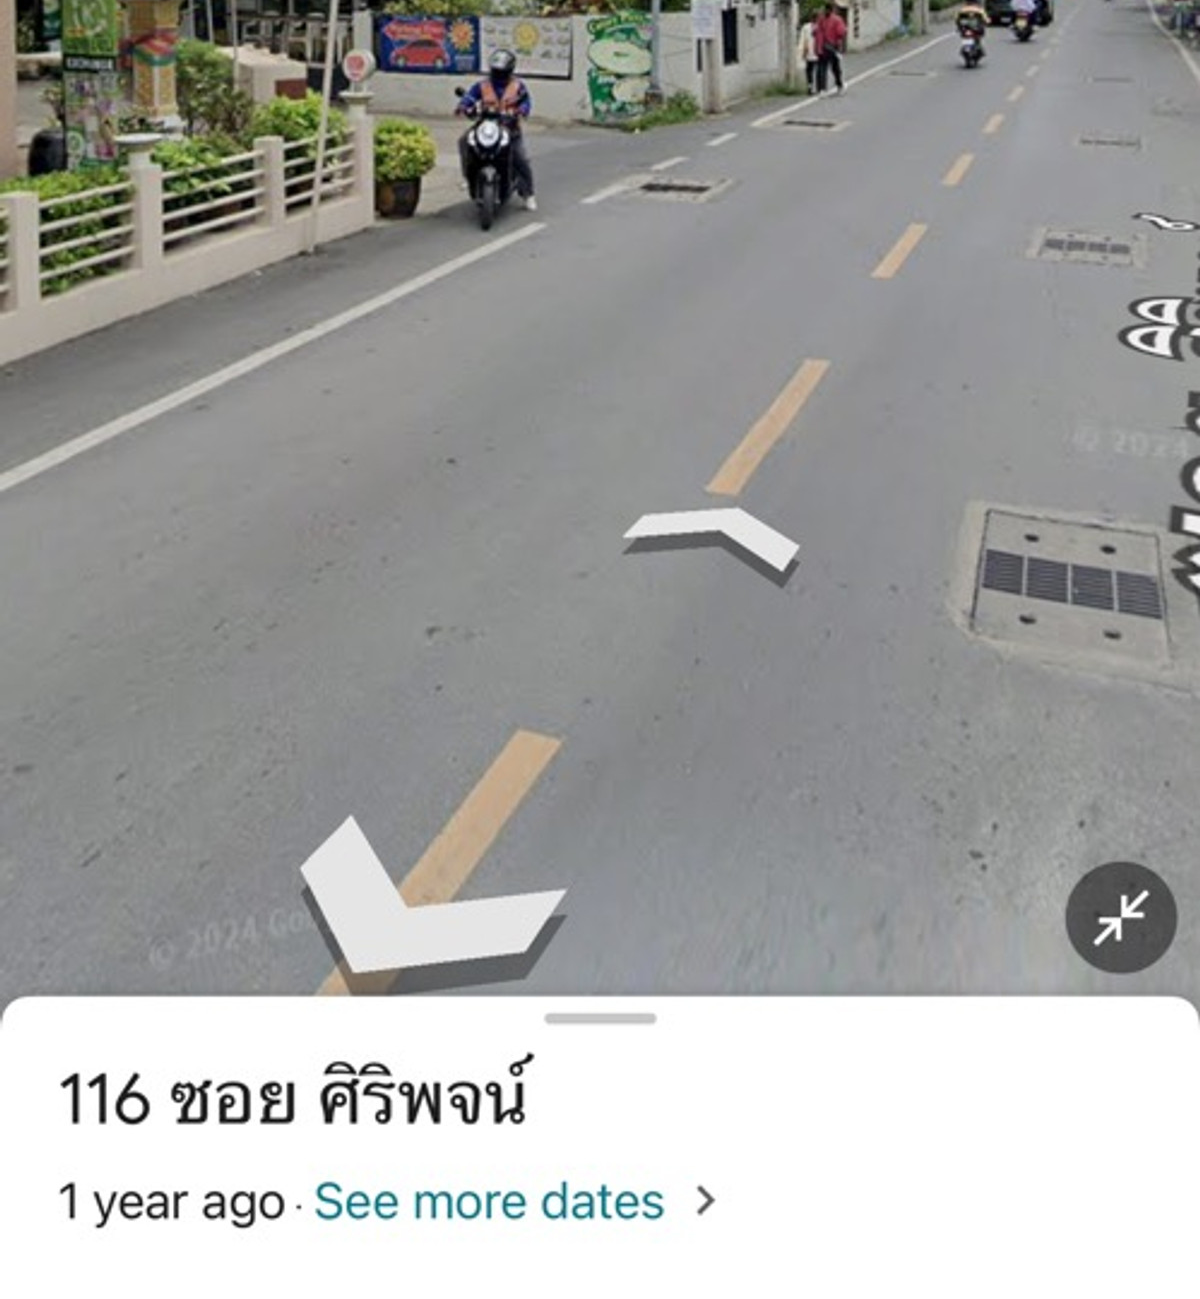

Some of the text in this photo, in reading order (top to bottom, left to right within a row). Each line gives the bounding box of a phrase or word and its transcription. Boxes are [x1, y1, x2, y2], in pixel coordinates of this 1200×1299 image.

[60, 1052, 535, 1125] 116 ซอย ศิริพจน์
[59, 1181, 665, 1229] 1 year ago See more dates
